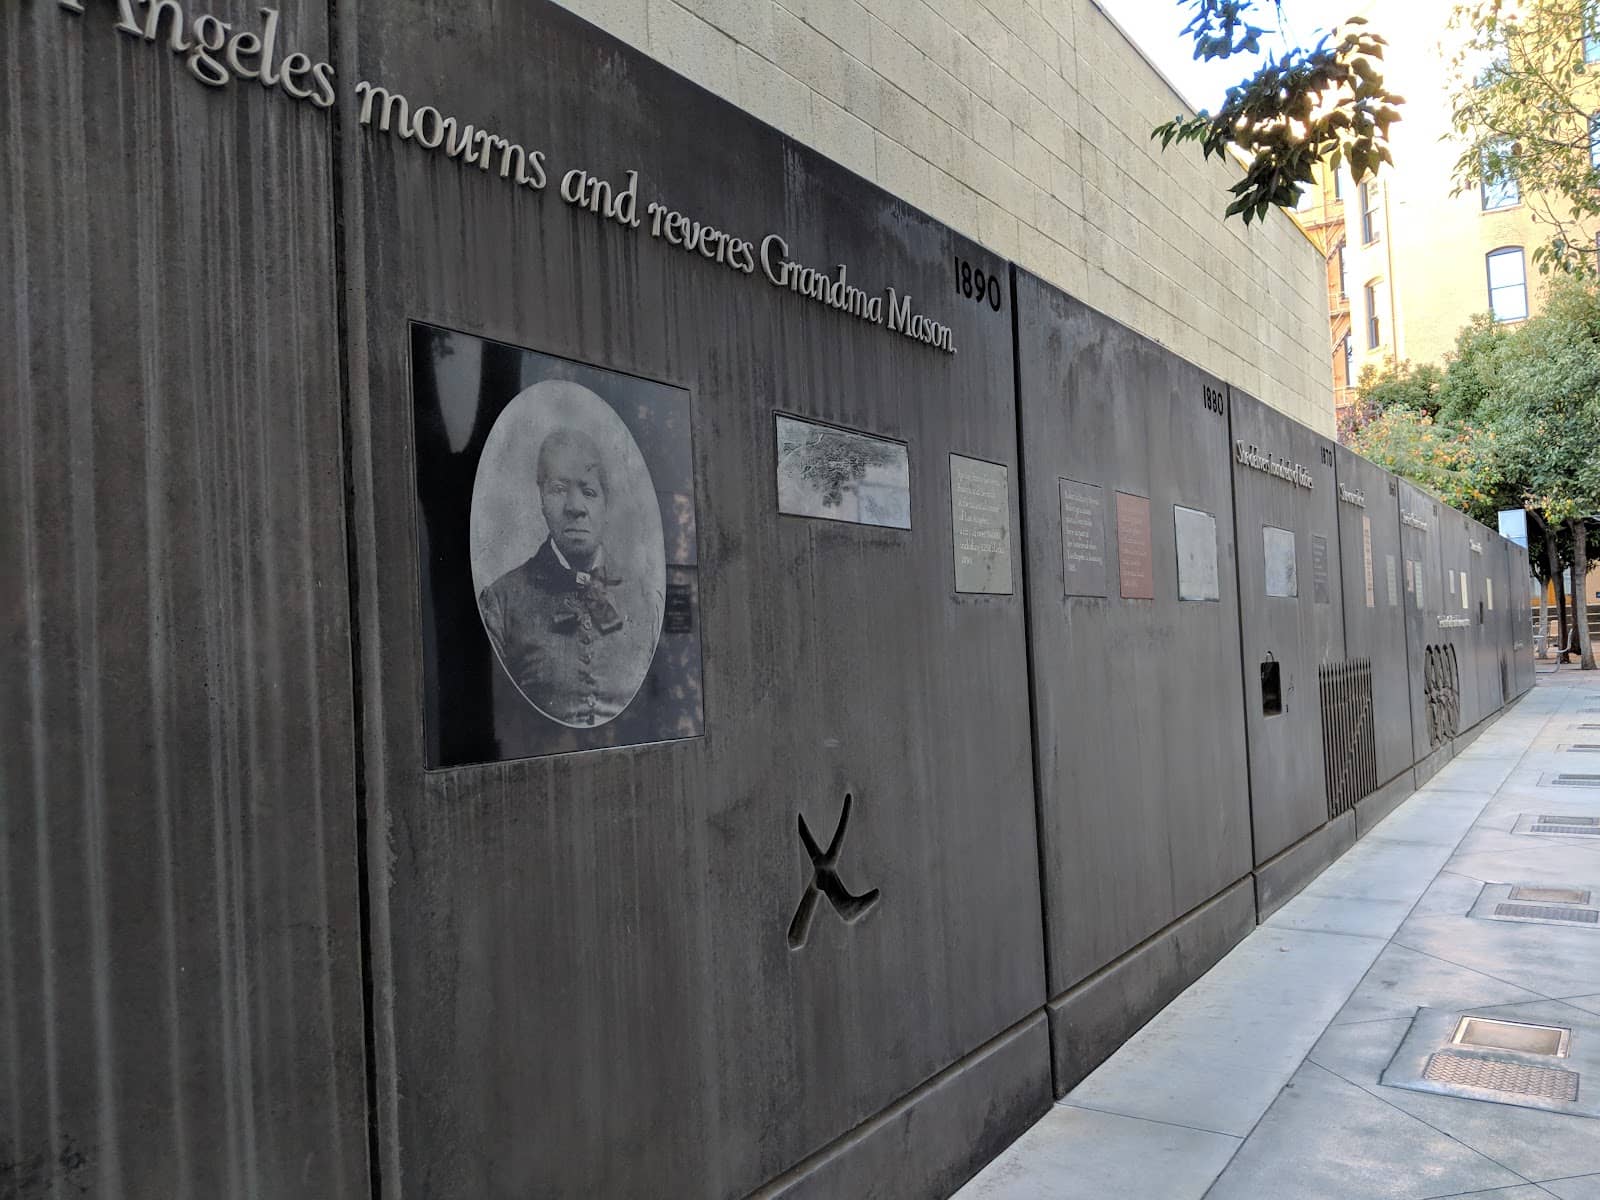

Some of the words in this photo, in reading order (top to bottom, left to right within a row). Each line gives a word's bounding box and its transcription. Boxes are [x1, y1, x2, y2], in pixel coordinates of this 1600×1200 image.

[58, 0, 336, 108] ngeles
[355, 80, 548, 190] mourns
[560, 169, 640, 228] and
[647, 202, 755, 274] reveres
[760, 234, 883, 325] Grandma
[886, 286, 957, 354] Mason.
[954, 256, 1000, 312] 1890
